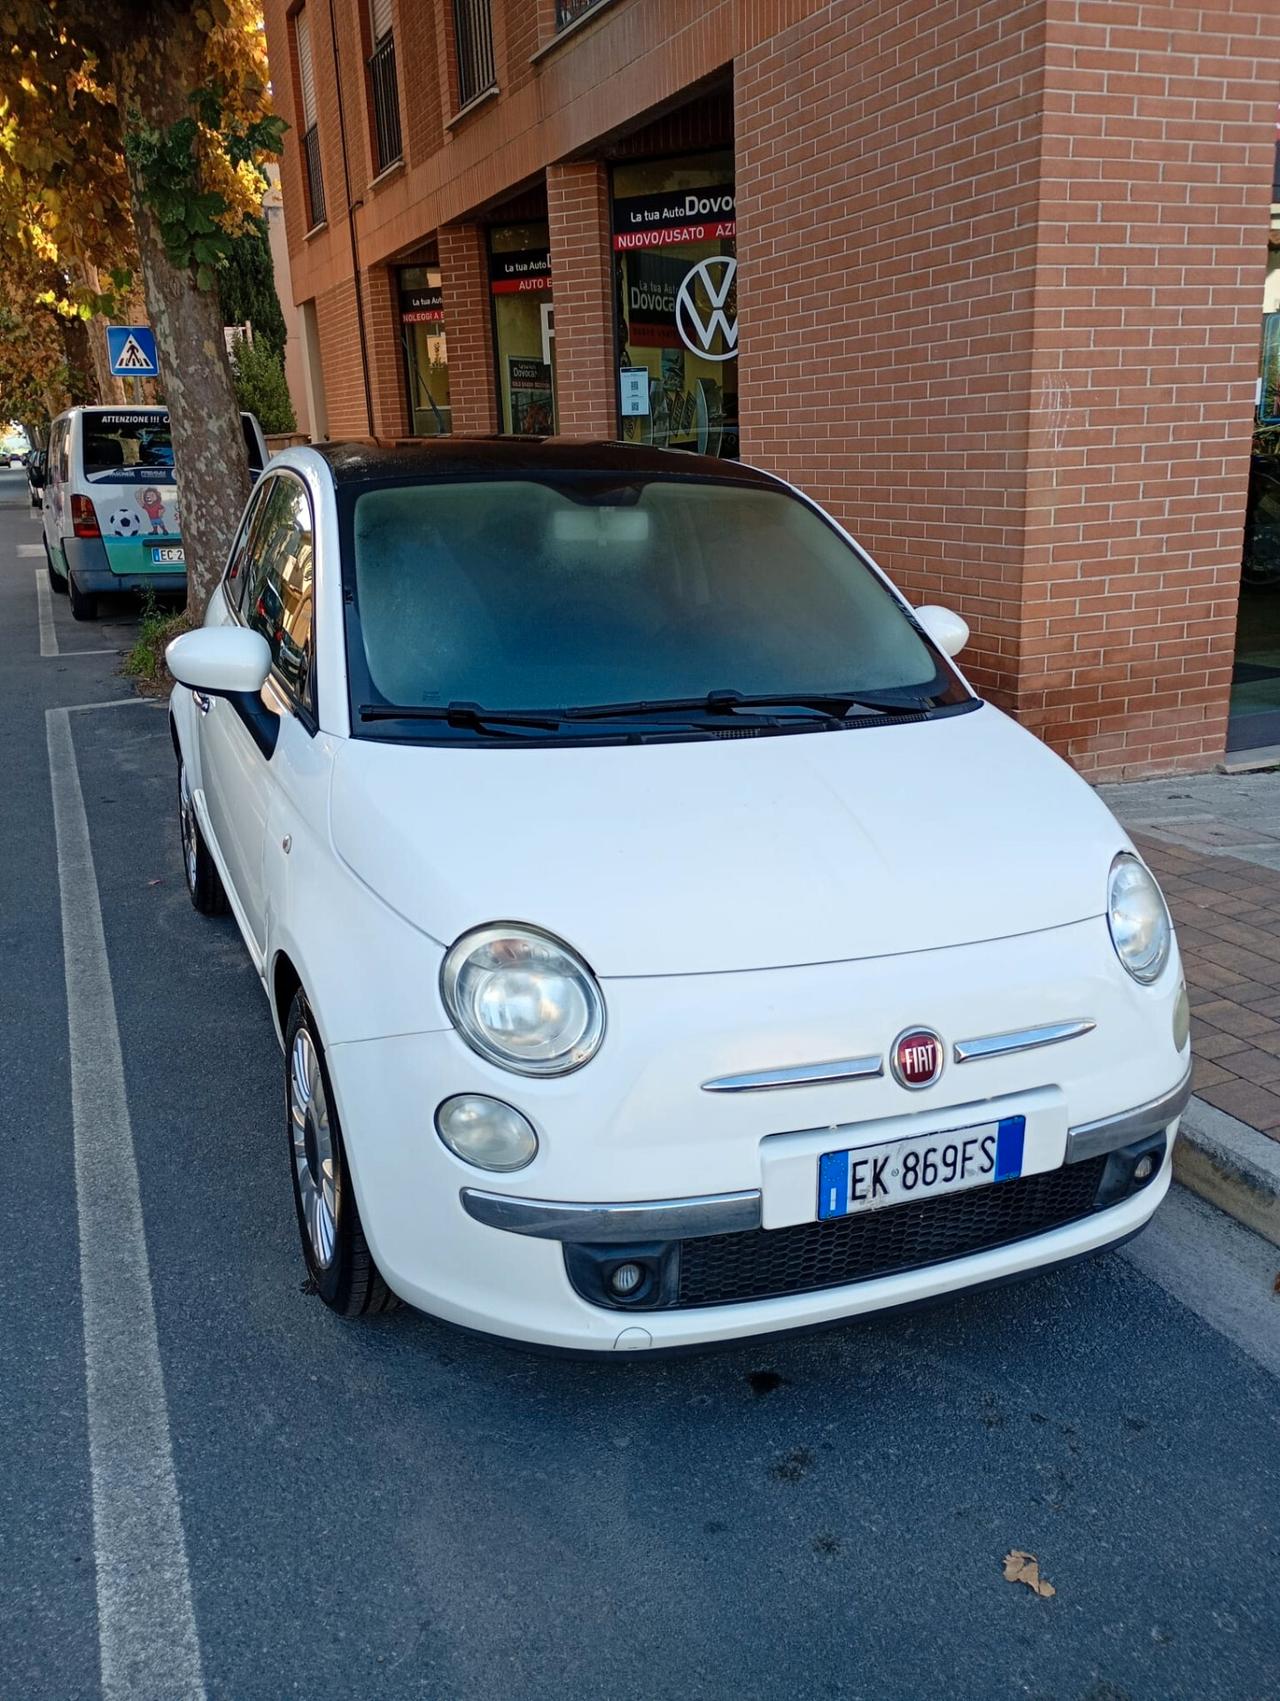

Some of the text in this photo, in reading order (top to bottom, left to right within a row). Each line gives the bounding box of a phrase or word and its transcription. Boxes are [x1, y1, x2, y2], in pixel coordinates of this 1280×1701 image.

[630, 212, 642, 223] La
[644, 210, 660, 221] tua
[685, 196, 737, 216] Dovo
[618, 226, 705, 248] NUOVO/USATO
[504, 264, 514, 273] La
[515, 263, 528, 271] tua
[519, 278, 544, 290] AUTO
[101, 415, 149, 424] ATTENZIONE
[160, 549, 174, 561] EC
[904, 1044, 934, 1075] FIAT
[851, 1135, 996, 1201] EK 869FS
